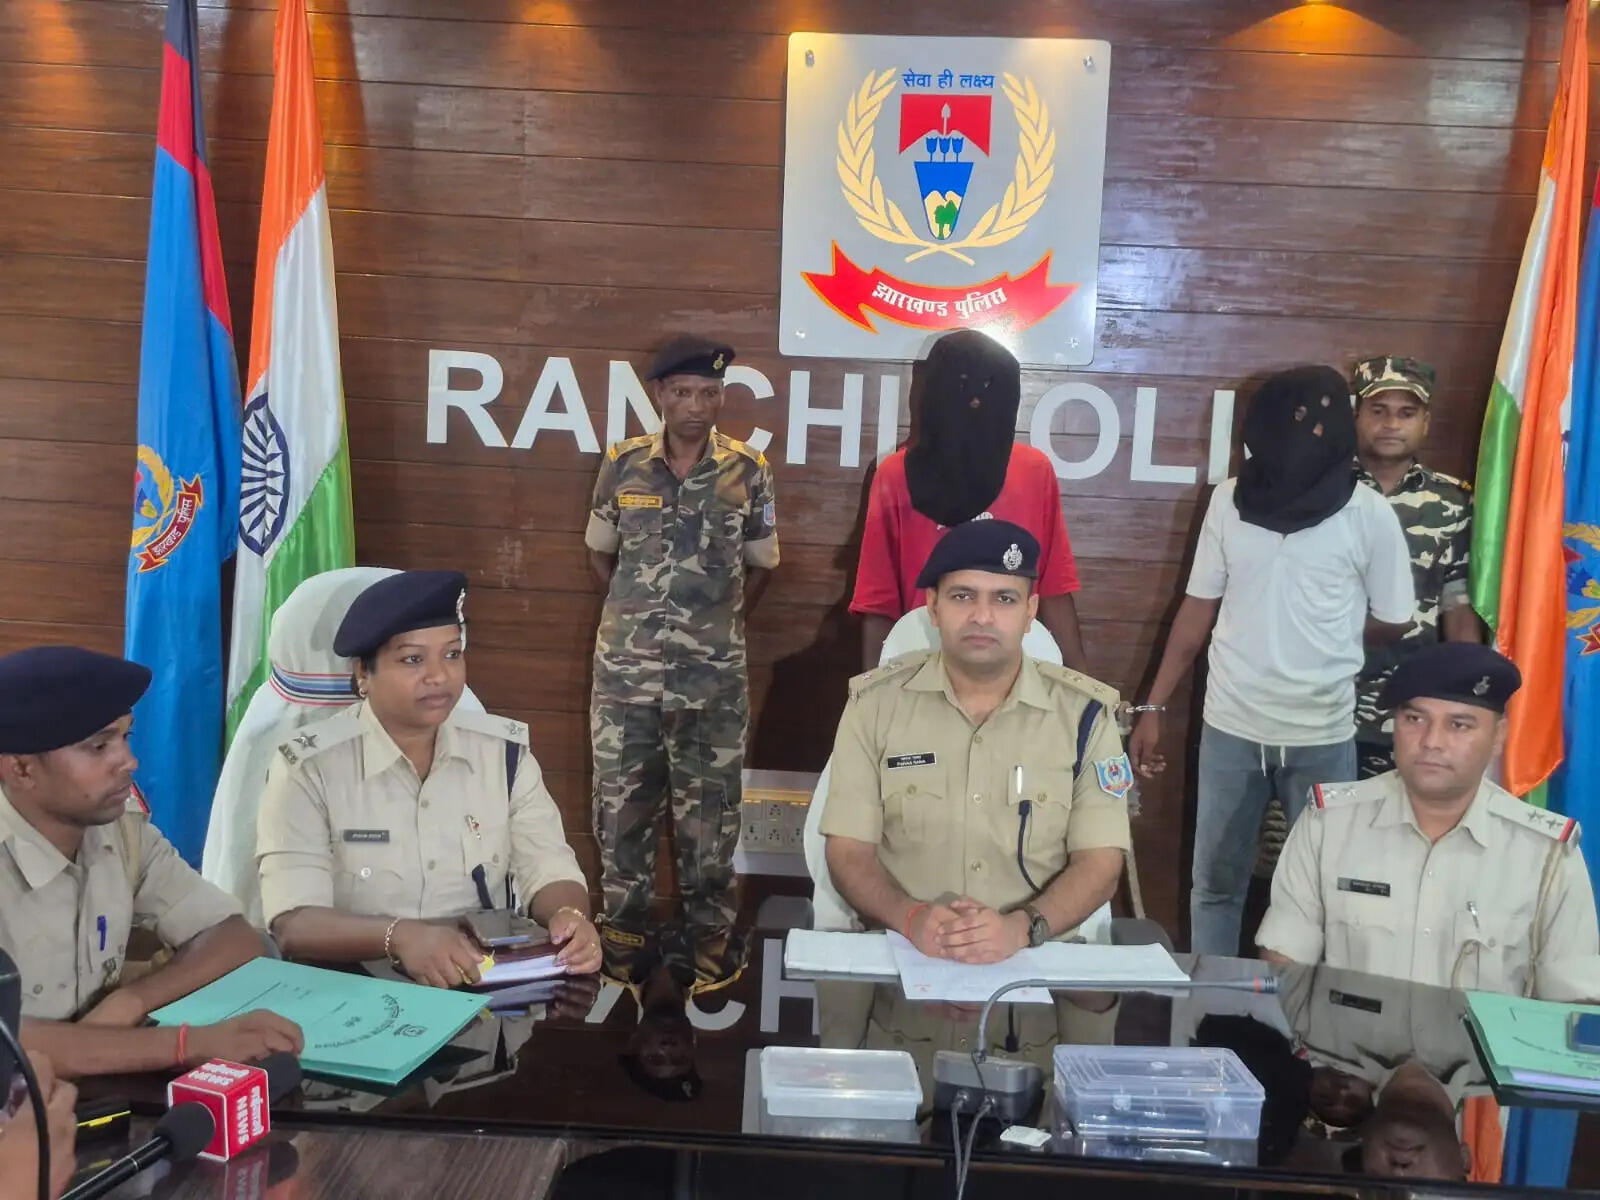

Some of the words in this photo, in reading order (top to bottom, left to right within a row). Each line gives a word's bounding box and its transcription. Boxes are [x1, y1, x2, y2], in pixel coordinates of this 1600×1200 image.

[903, 68, 931, 88] सेवा
[938, 69, 953, 89] ही
[960, 73, 995, 89] लक्ष्य
[871, 280, 948, 317] झारखण्ड
[954, 287, 1008, 319] पुलिस
[1030, 382, 1252, 485] OLI
[236, 1095, 249, 1146] NEWS
